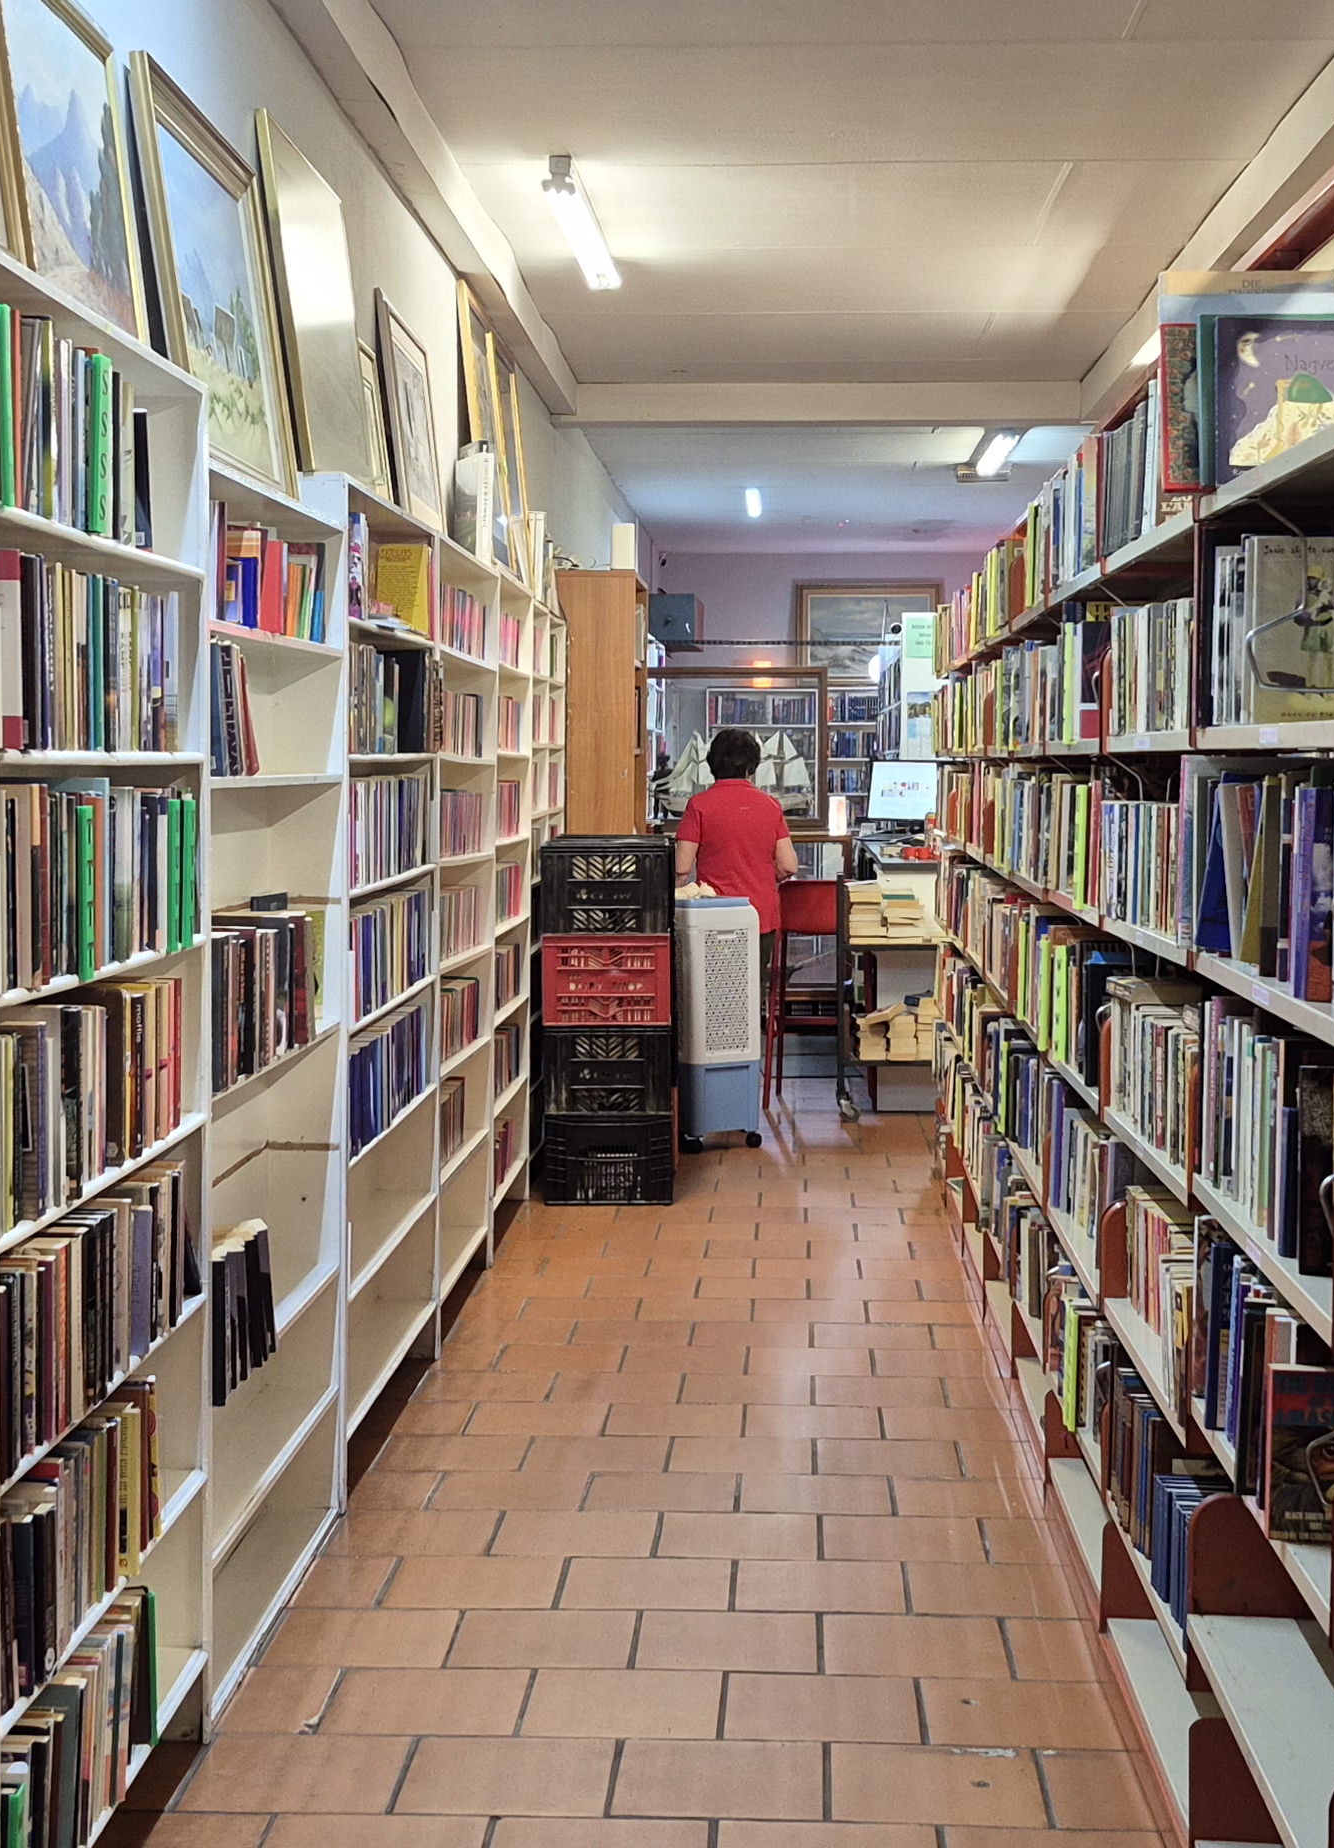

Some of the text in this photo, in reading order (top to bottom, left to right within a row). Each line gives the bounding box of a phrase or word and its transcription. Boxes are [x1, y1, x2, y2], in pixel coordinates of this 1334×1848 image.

[1242, 278, 1263, 290] DIE
[99, 370, 109, 520] S S S S
